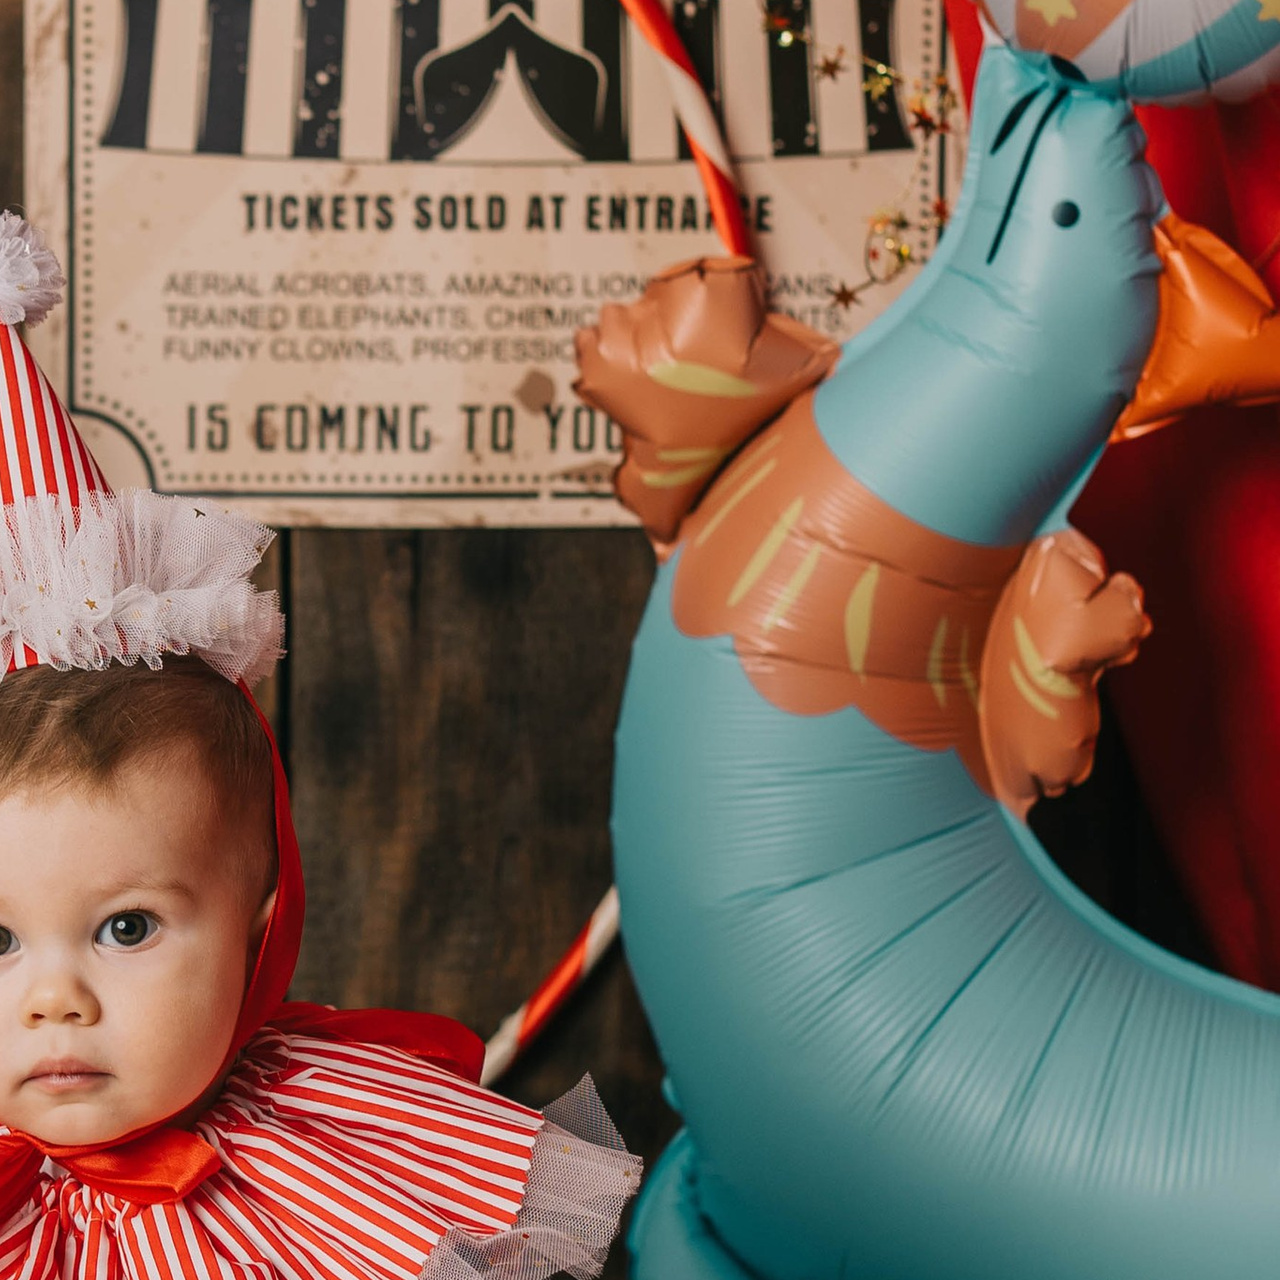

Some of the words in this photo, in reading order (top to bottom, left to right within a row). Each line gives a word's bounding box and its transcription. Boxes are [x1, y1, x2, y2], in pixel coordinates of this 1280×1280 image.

[241, 193, 394, 233] TICKETS
[414, 193, 508, 233] SOLD
[526, 193, 566, 233] AT
[586, 194, 773, 233] ENTRAE
[164, 272, 262, 297] AERIAL
[271, 272, 432, 300] ACROBATS,
[443, 272, 573, 297] AMAZING
[166, 304, 291, 330] TRAINED
[164, 336, 262, 363] FUNNY
[270, 336, 404, 365] CLOWNS,
[186, 403, 230, 453] IS
[255, 403, 431, 454] COMING
[460, 403, 516, 453] TO
